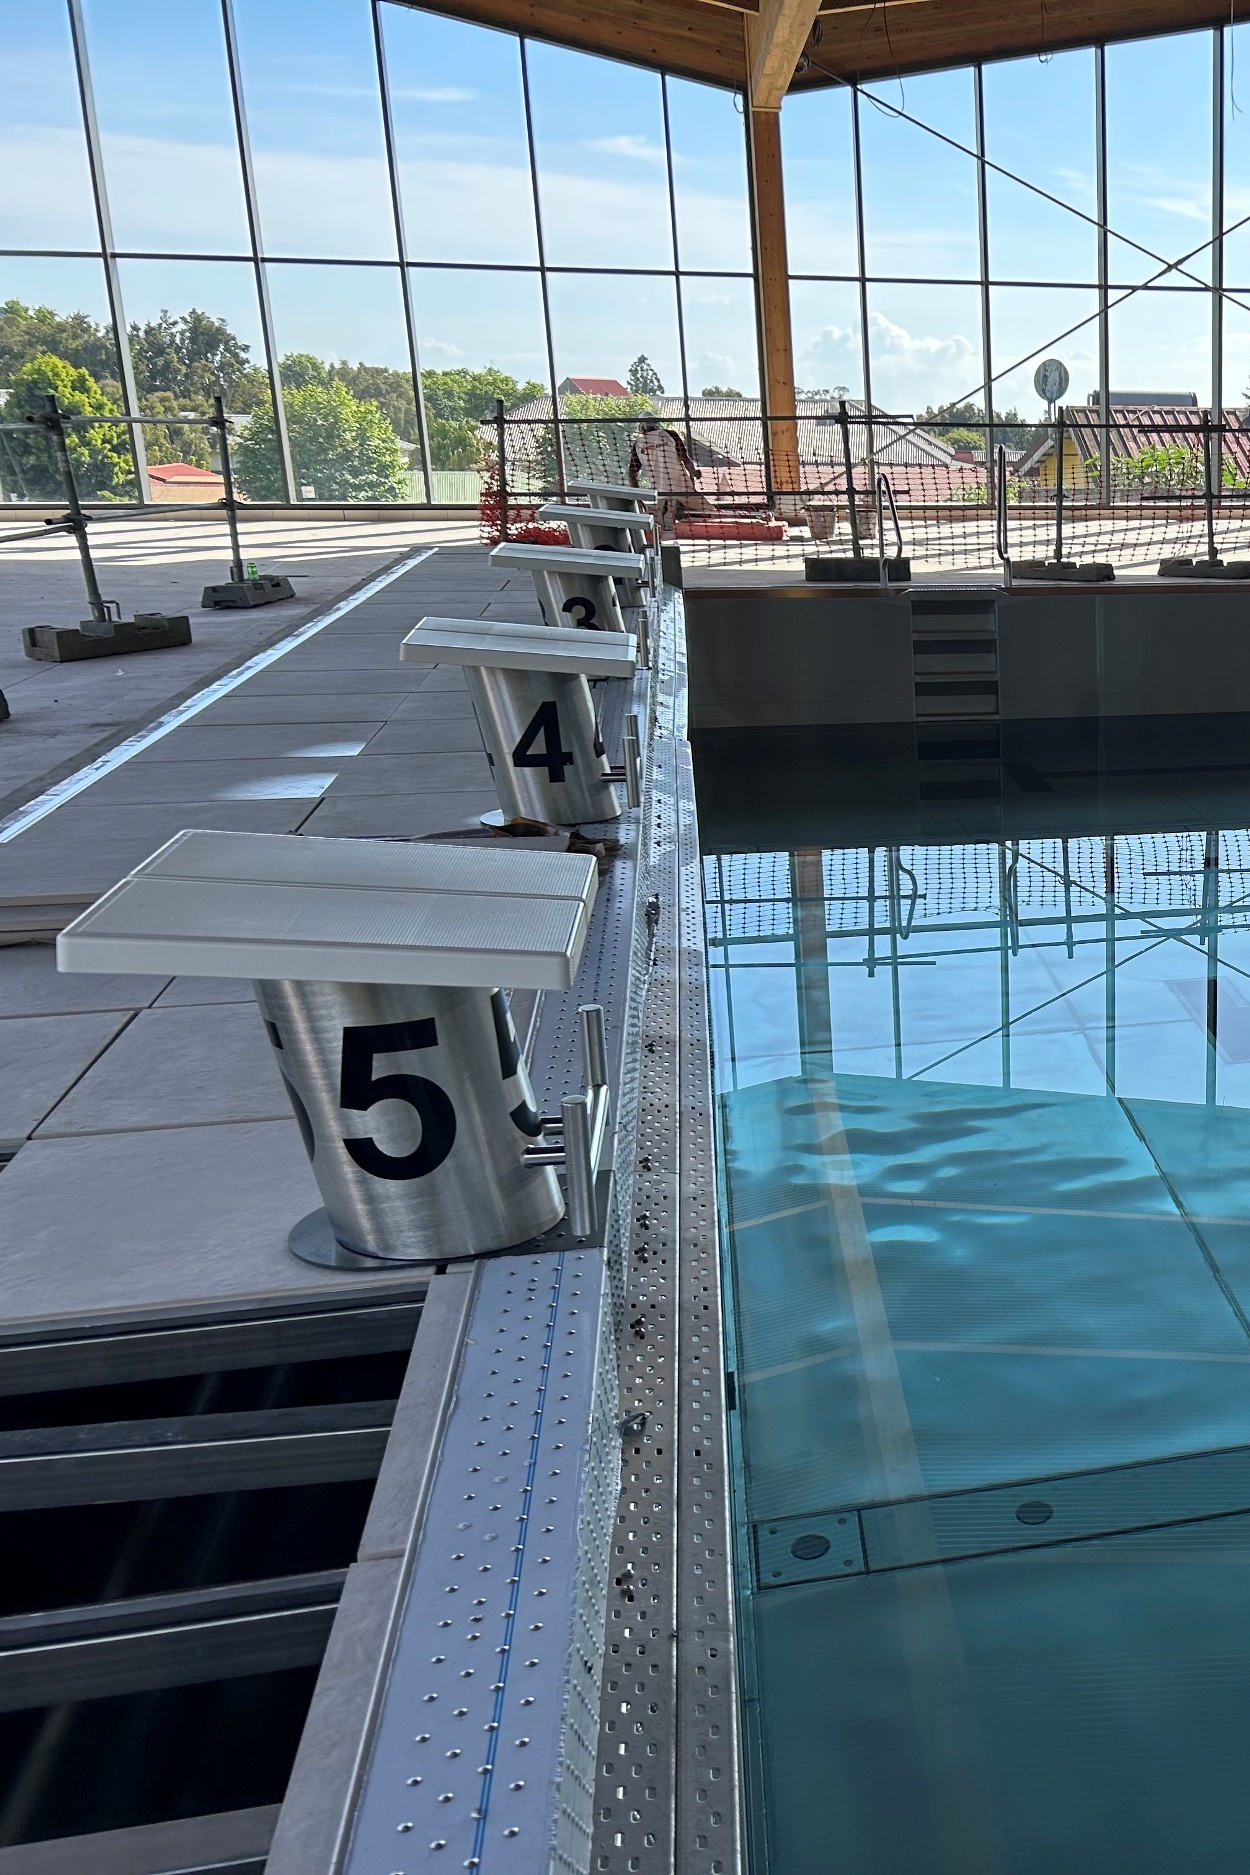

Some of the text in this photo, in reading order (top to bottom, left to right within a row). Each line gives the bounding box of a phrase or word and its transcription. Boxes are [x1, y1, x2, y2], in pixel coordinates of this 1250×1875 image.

[562, 596, 601, 630] 3
[512, 700, 574, 783] 4
[340, 1017, 457, 1181] 5
